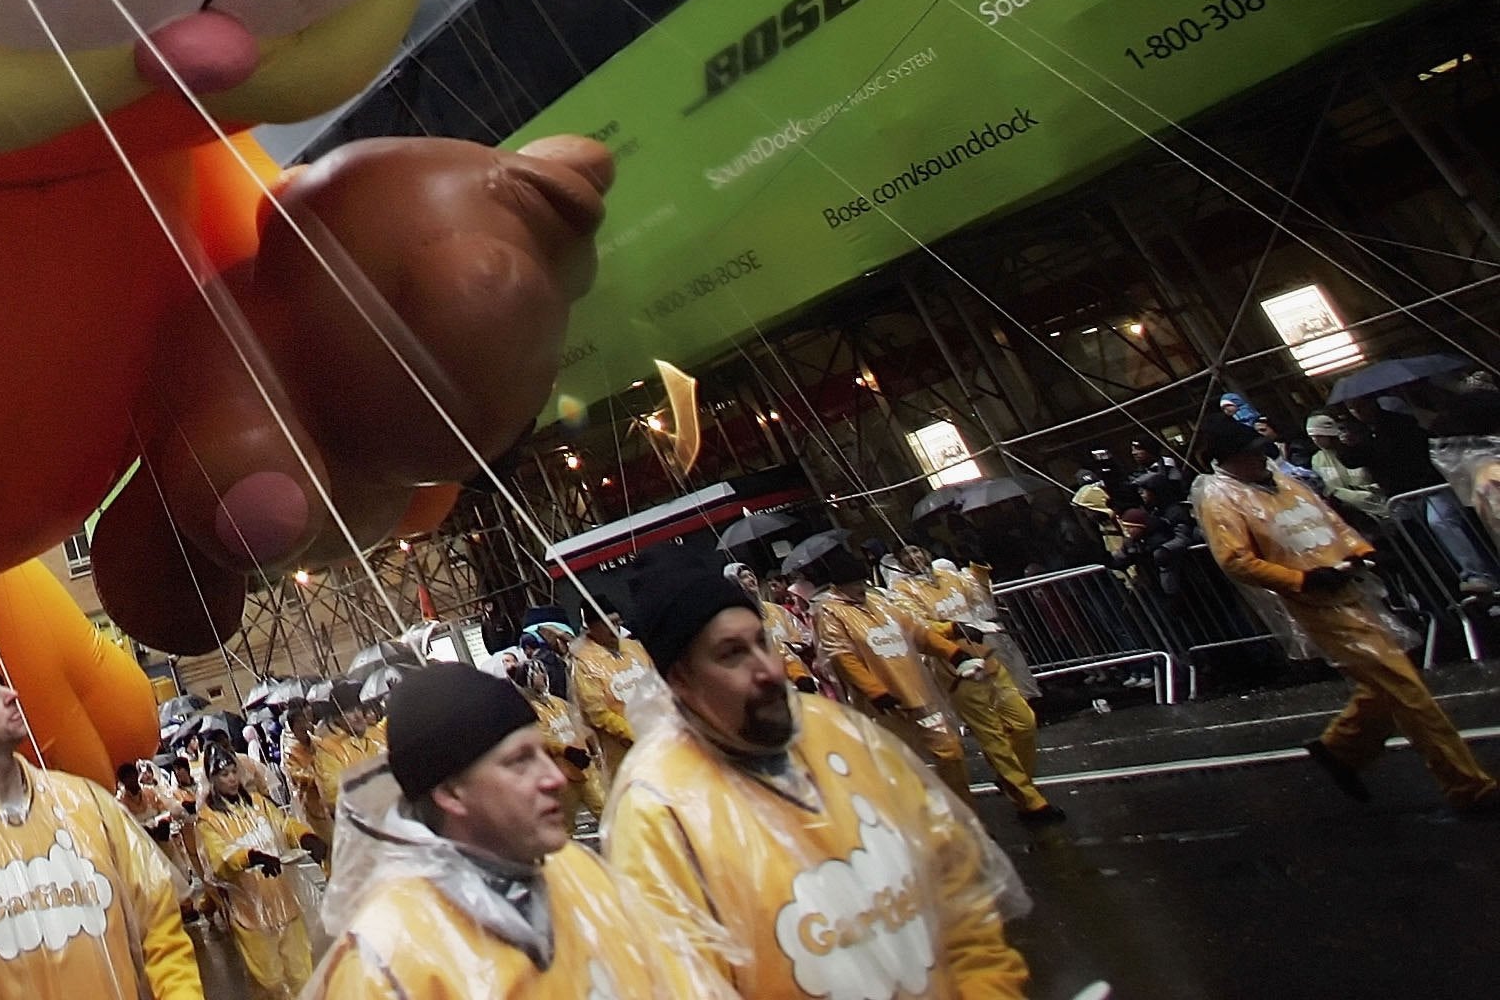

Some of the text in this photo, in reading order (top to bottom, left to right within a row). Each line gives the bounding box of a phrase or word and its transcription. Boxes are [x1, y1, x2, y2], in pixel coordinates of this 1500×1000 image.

[705, 117, 811, 190] SoundDock
[849, 75, 888, 108] MUSIC
[886, 47, 939, 84] SYSTEM
[822, 107, 1041, 230] Bose.com/sounddock
